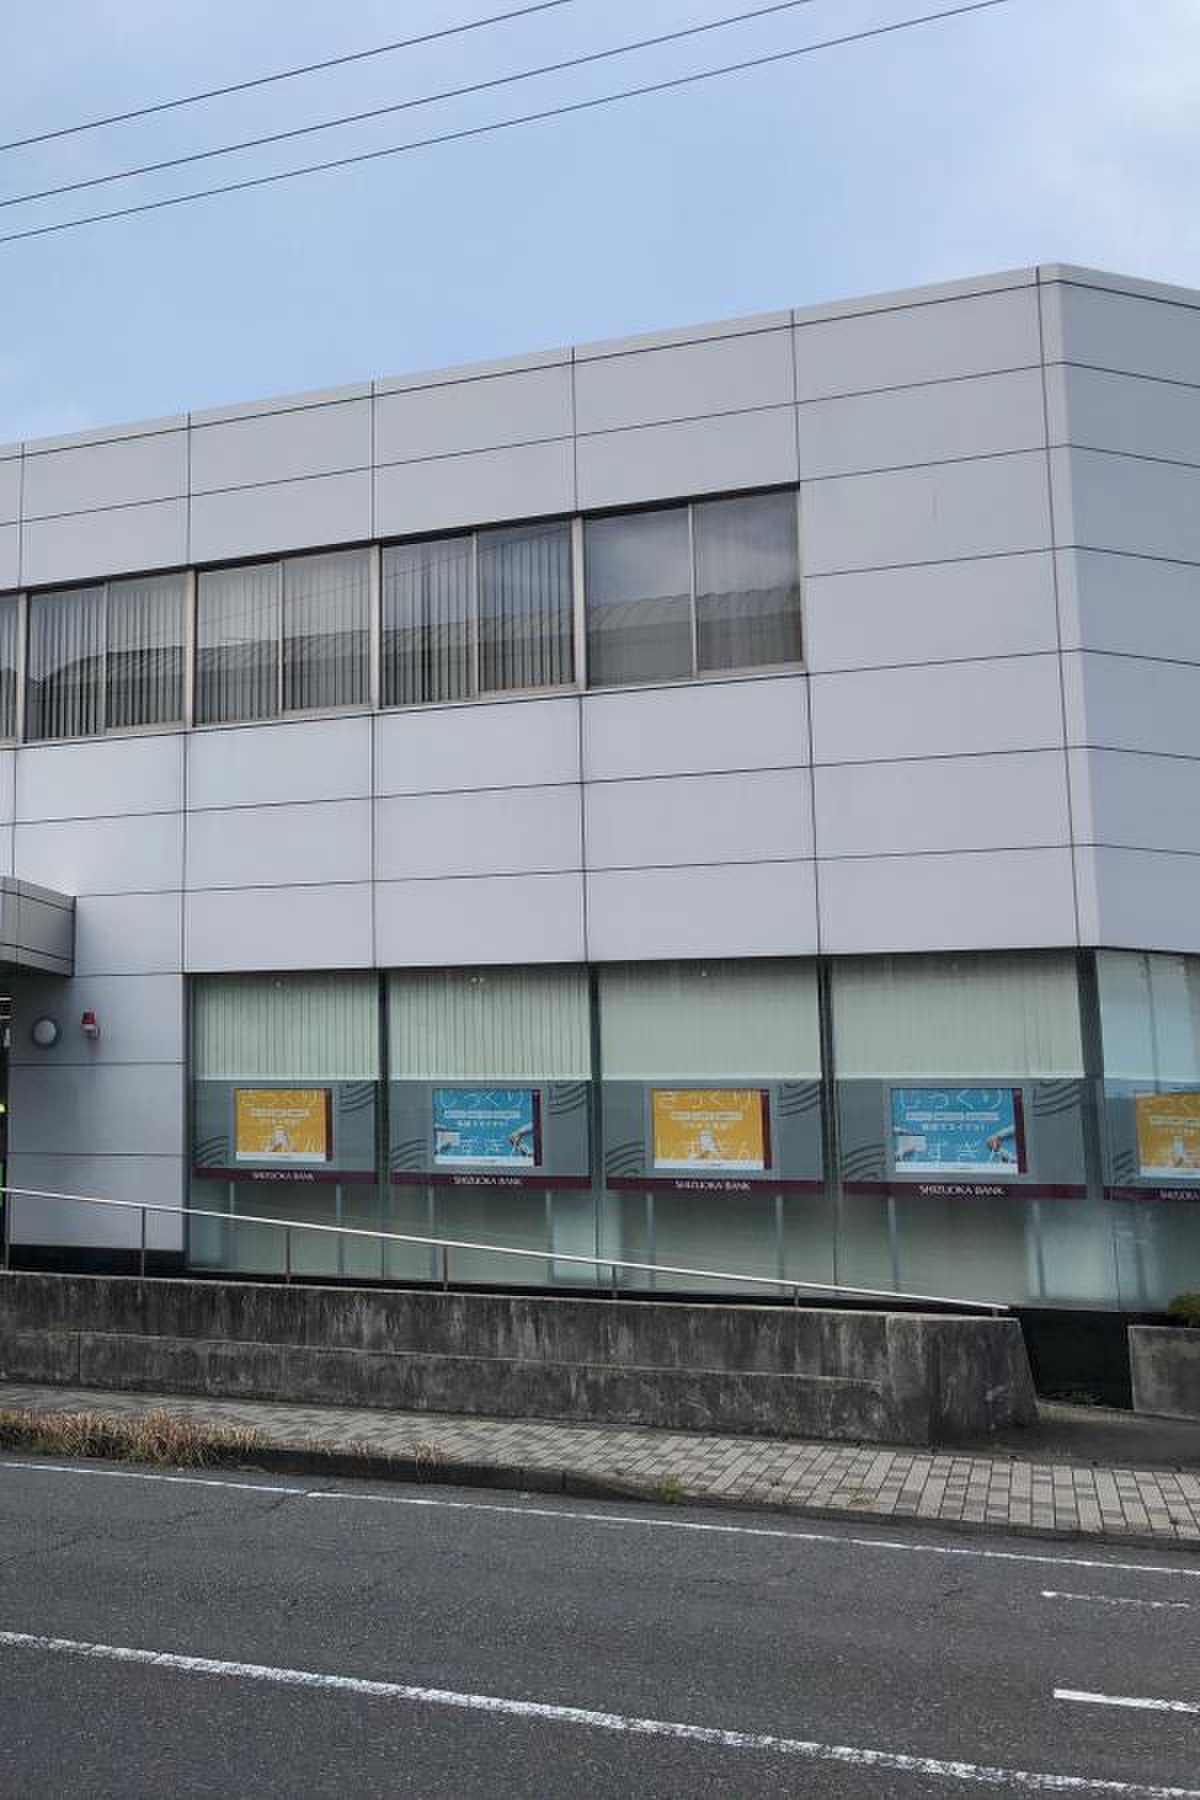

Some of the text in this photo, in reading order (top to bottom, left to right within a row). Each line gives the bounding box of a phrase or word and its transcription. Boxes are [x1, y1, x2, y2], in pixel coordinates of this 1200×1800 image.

[452, 1176, 496, 1185] SHIZUOKA
[675, 1180, 751, 1191] SHIZUOKA BANK
[919, 1184, 1005, 1196] SHIZUOKA BANK
